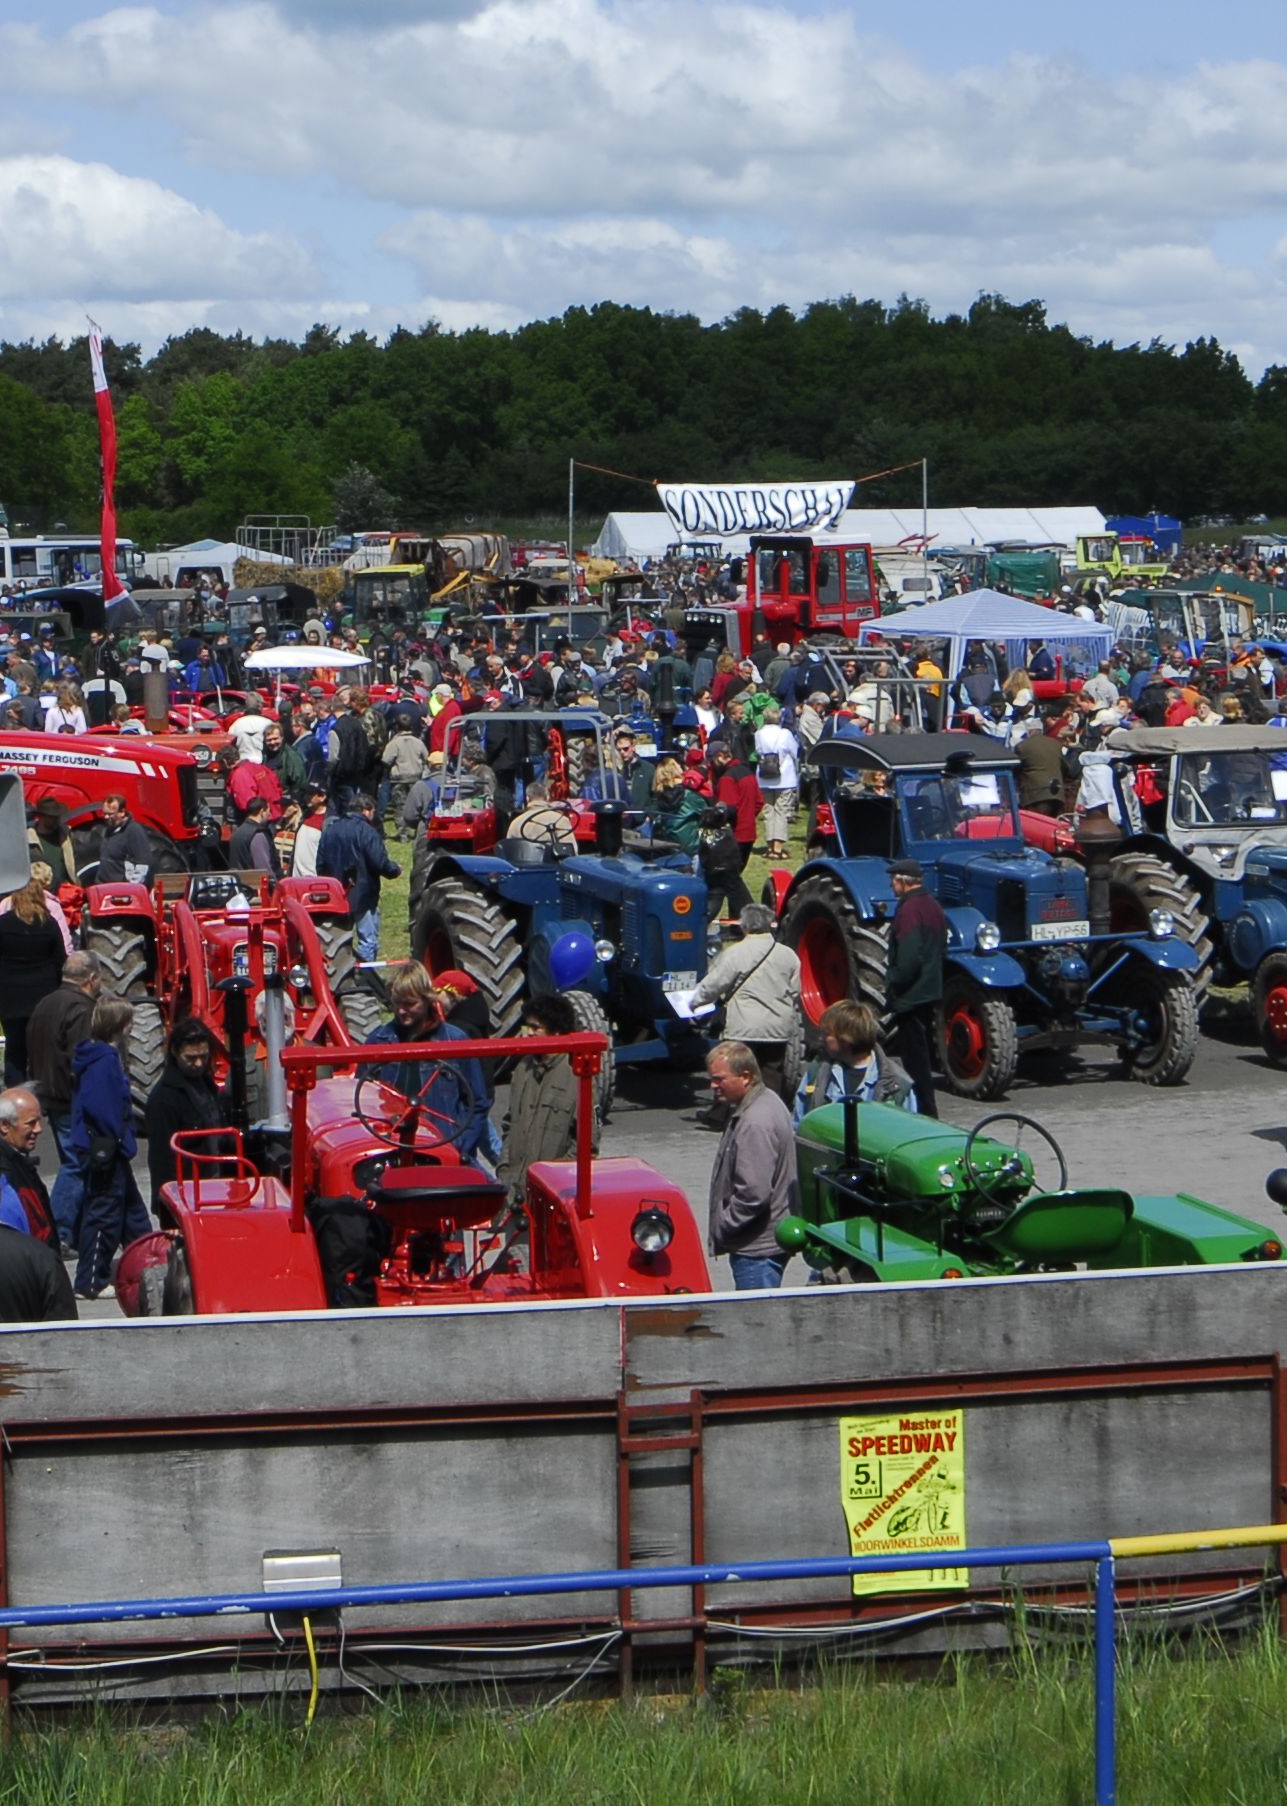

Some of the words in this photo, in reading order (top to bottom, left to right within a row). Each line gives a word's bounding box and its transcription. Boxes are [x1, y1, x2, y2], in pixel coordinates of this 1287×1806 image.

[42, 754, 100, 768] FERGUSON
[899, 1419, 941, 1431] Master
[945, 1415, 957, 1429] of
[848, 1431, 957, 1457] SPEEDWAY
[854, 1463, 876, 1485] 5.
[850, 1486, 878, 1495] Mai
[853, 1455, 939, 1538] Flutlichtrennen
